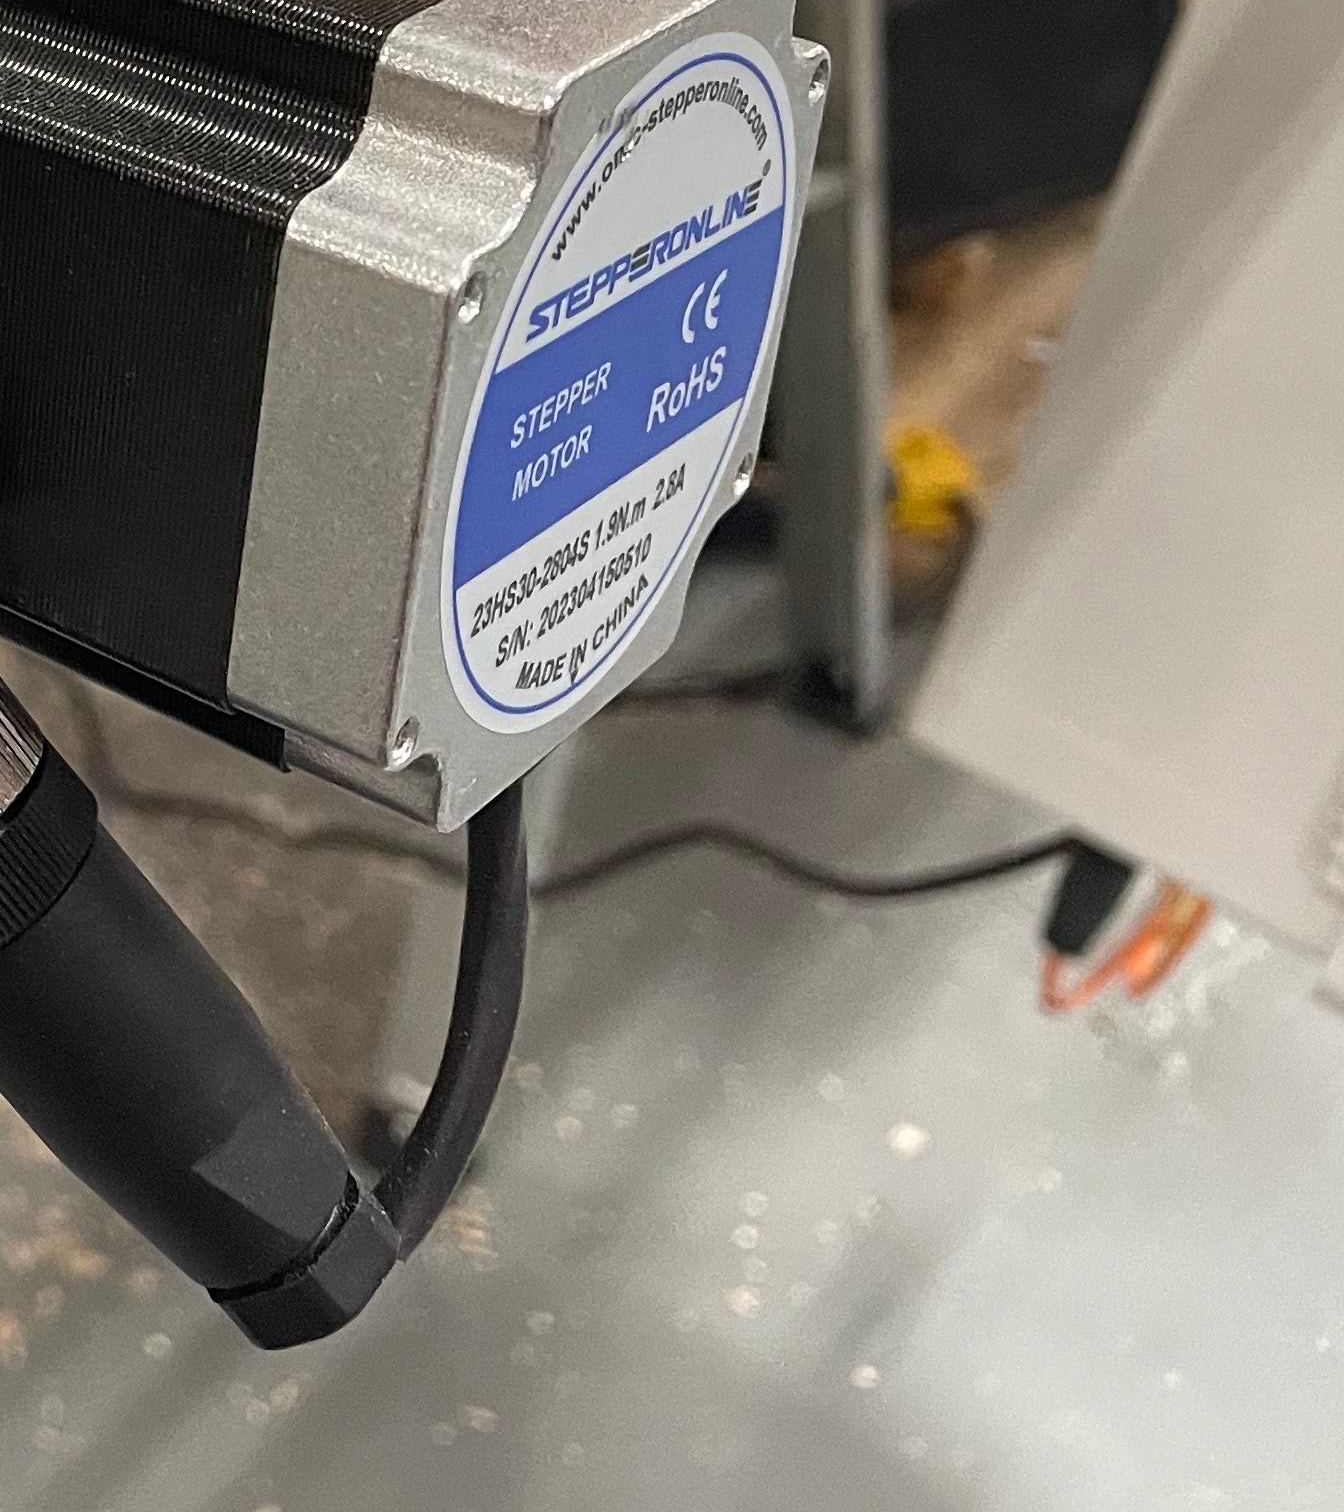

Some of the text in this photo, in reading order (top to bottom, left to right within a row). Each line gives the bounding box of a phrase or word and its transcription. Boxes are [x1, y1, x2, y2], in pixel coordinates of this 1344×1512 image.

[526, 178, 763, 343] STEPPERONLINE
[682, 269, 728, 343] CE
[511, 362, 611, 448] STEPPER
[646, 346, 726, 432] RoHS
[513, 425, 592, 501] MOTOR
[471, 530, 590, 637] 23HS30-2804S
[653, 463, 685, 510] 2.8A
[496, 619, 533, 667] S/N:
[515, 573, 649, 689] MADE IN CHINA
